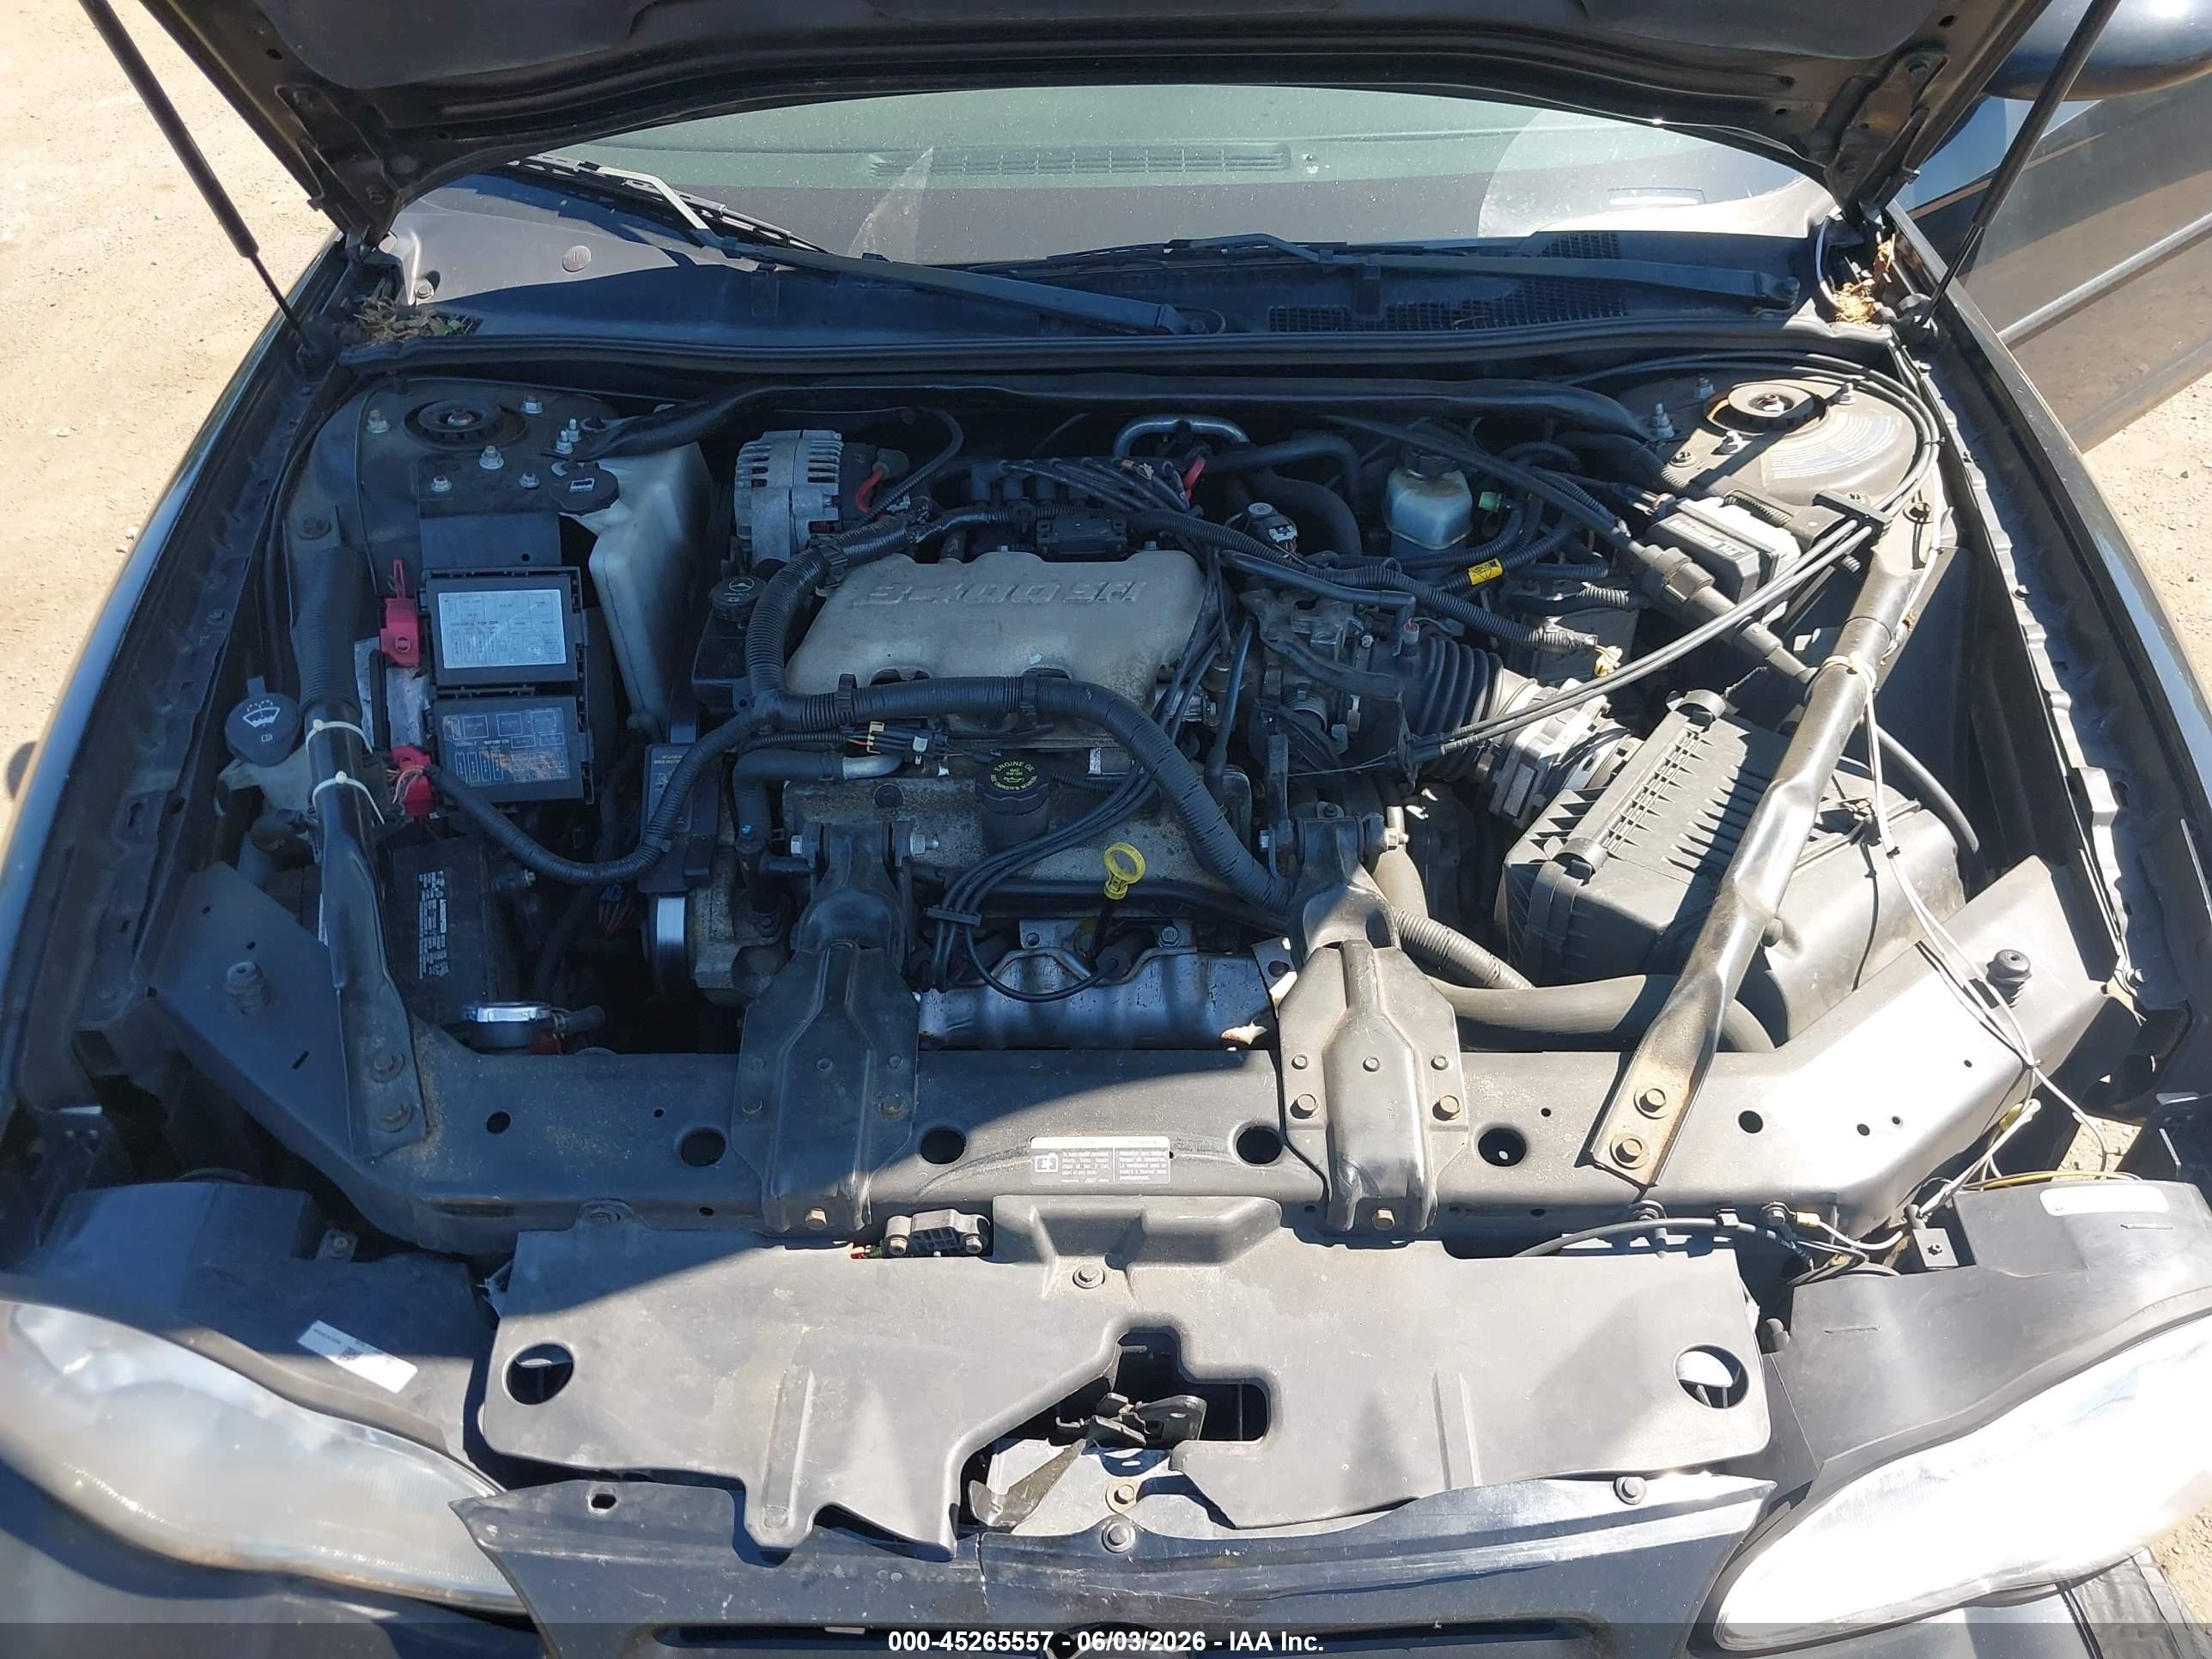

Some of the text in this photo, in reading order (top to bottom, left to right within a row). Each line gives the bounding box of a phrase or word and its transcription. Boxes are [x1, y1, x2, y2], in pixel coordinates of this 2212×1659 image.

[994, 761, 1036, 774] ENGINE OIL
[1020, 775, 1038, 789] MANUAL
